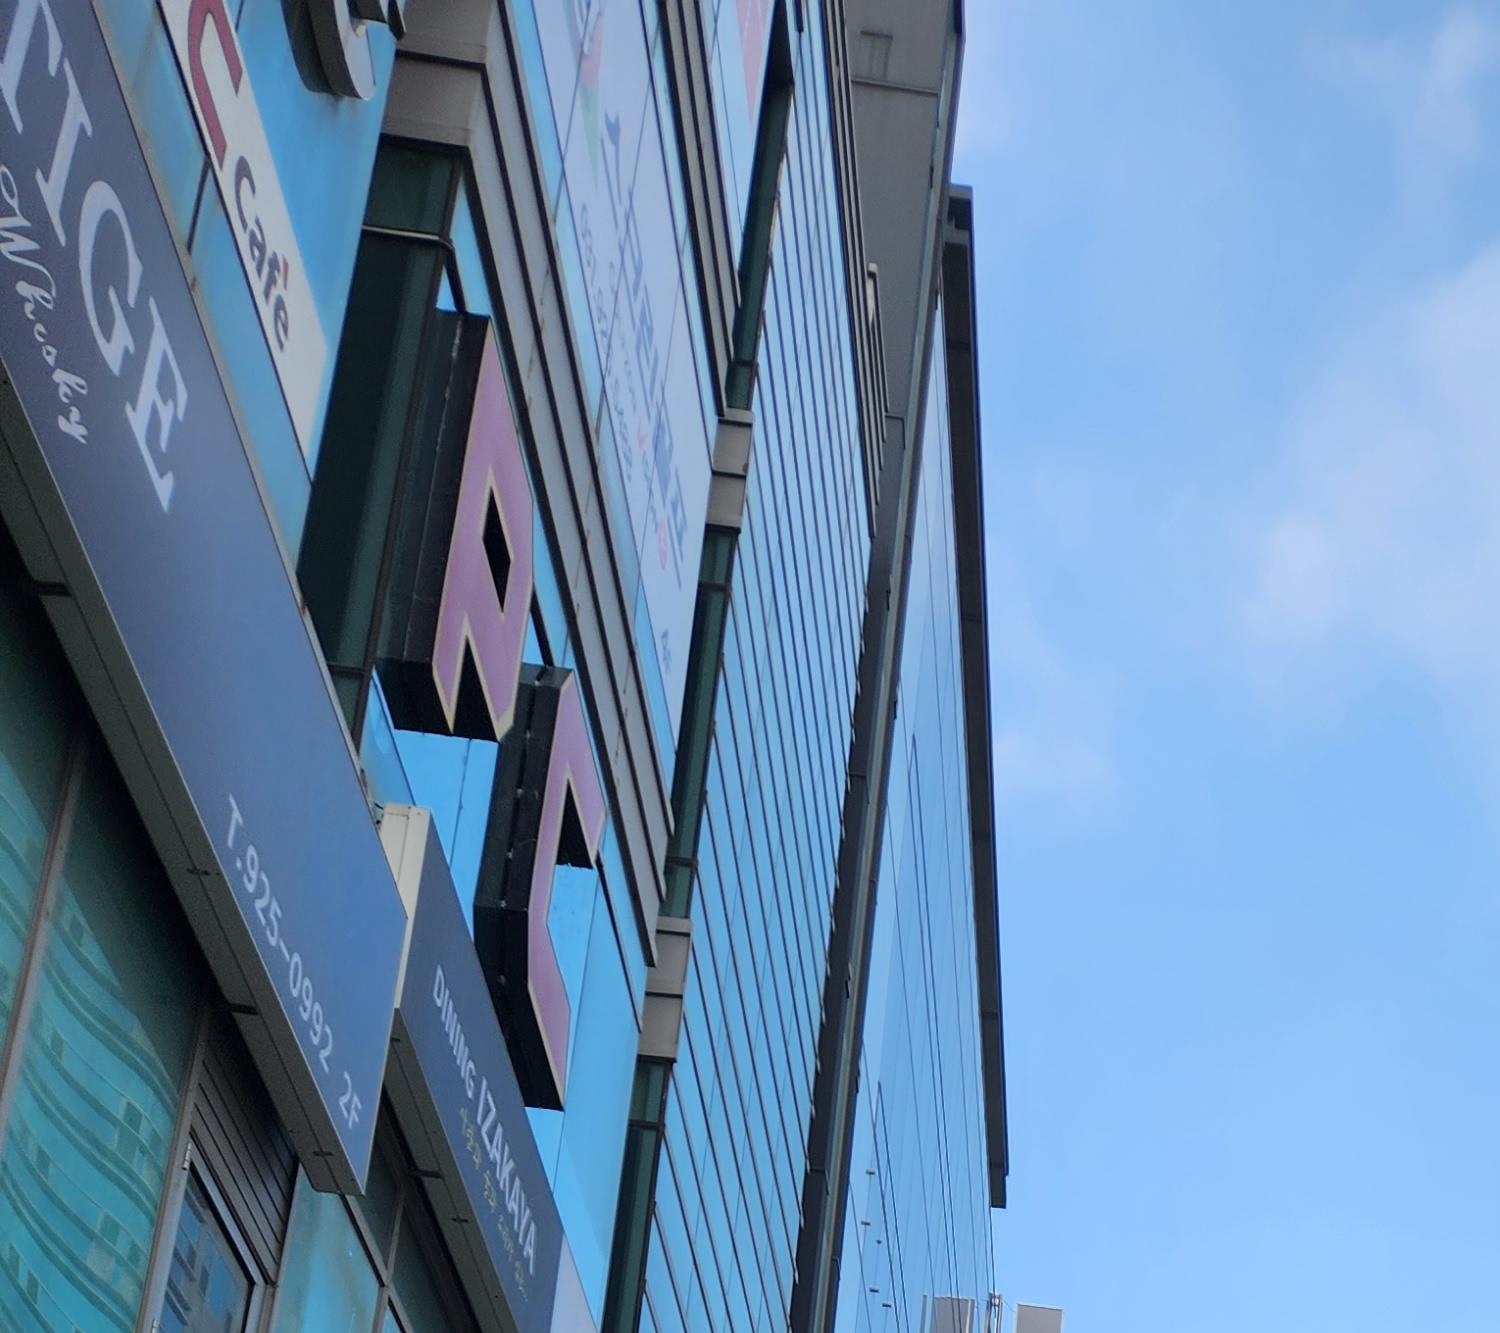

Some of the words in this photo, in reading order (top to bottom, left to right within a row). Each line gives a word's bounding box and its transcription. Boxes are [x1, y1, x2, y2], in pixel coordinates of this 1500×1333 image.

[601, 110, 688, 589] 스크린골프
[339, 1071, 361, 1128] 2F
[433, 964, 475, 1099] DINING
[477, 1076, 537, 1275] IZAKAYA
